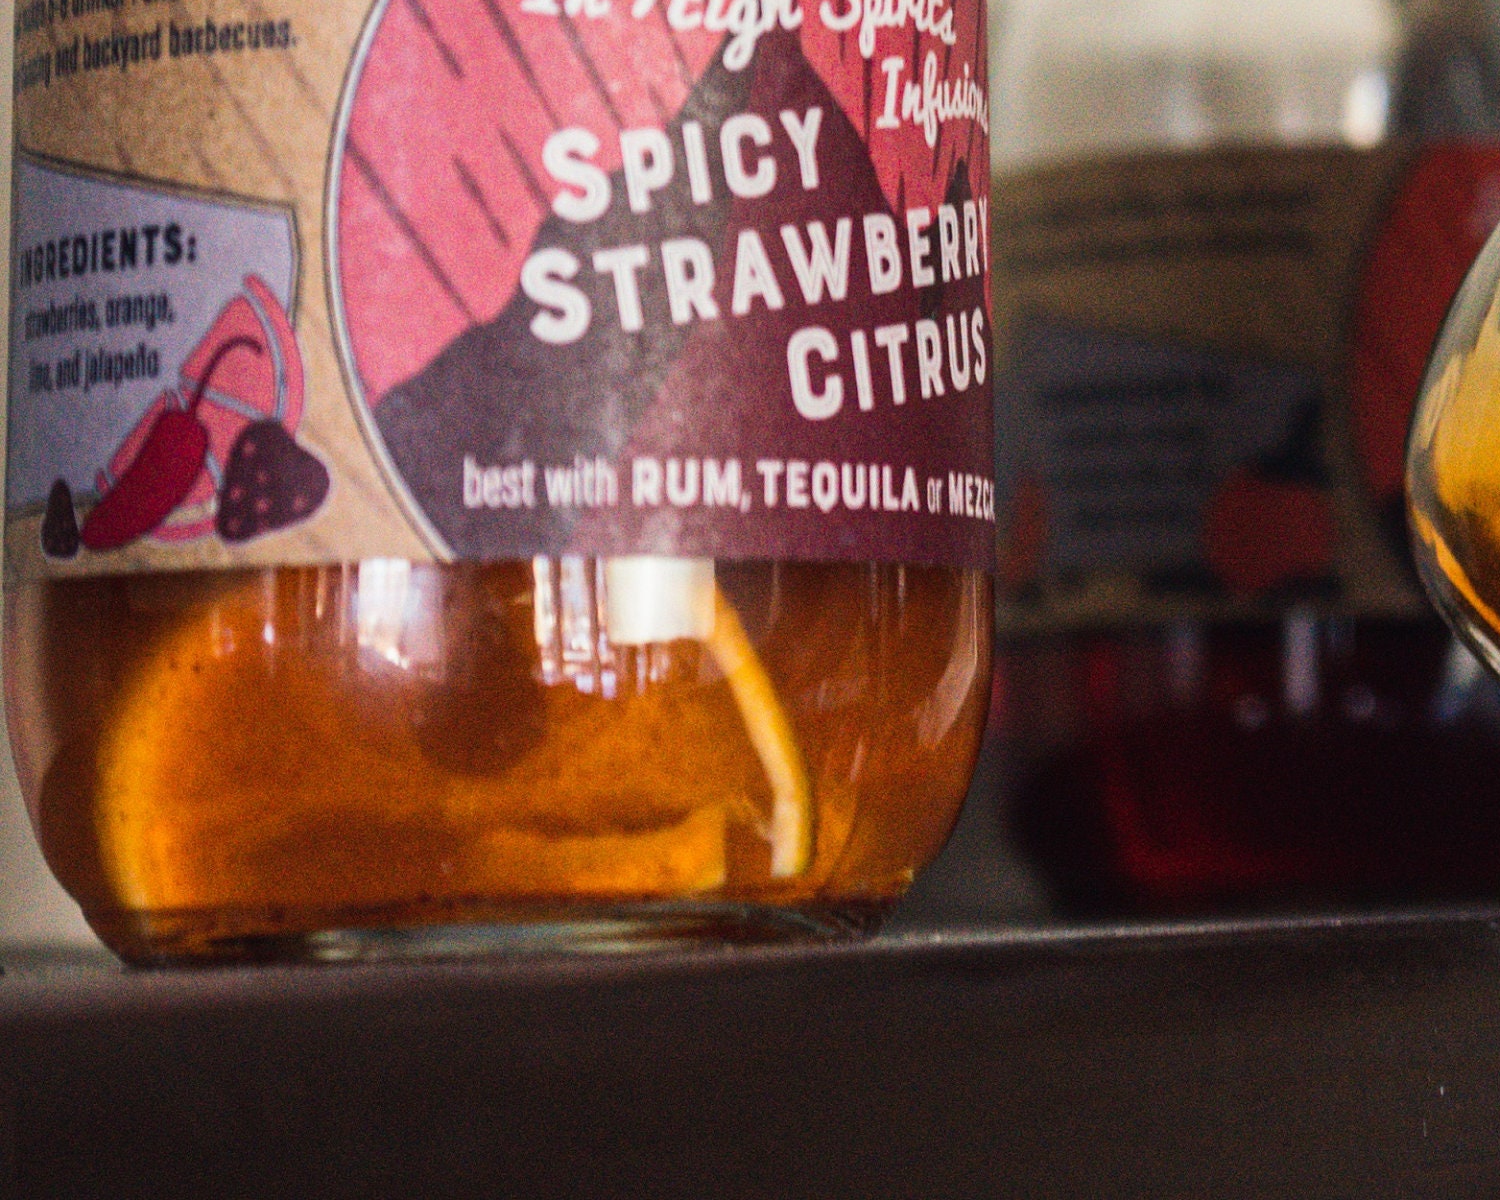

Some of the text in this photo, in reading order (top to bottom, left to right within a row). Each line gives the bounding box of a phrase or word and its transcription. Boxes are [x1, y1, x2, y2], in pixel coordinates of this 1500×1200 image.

[83, 21, 161, 73] backyard
[168, 17, 299, 58] barbecues.
[541, 106, 824, 222] SPICY
[105, 293, 176, 332] orange,
[520, 198, 990, 345] STRAWBERRY
[785, 306, 987, 422] CITRUS
[461, 453, 535, 510] best
[544, 453, 618, 508] with
[630, 456, 751, 512] RUM,
[756, 457, 919, 513] TEQUILA
[926, 476, 944, 514] or
